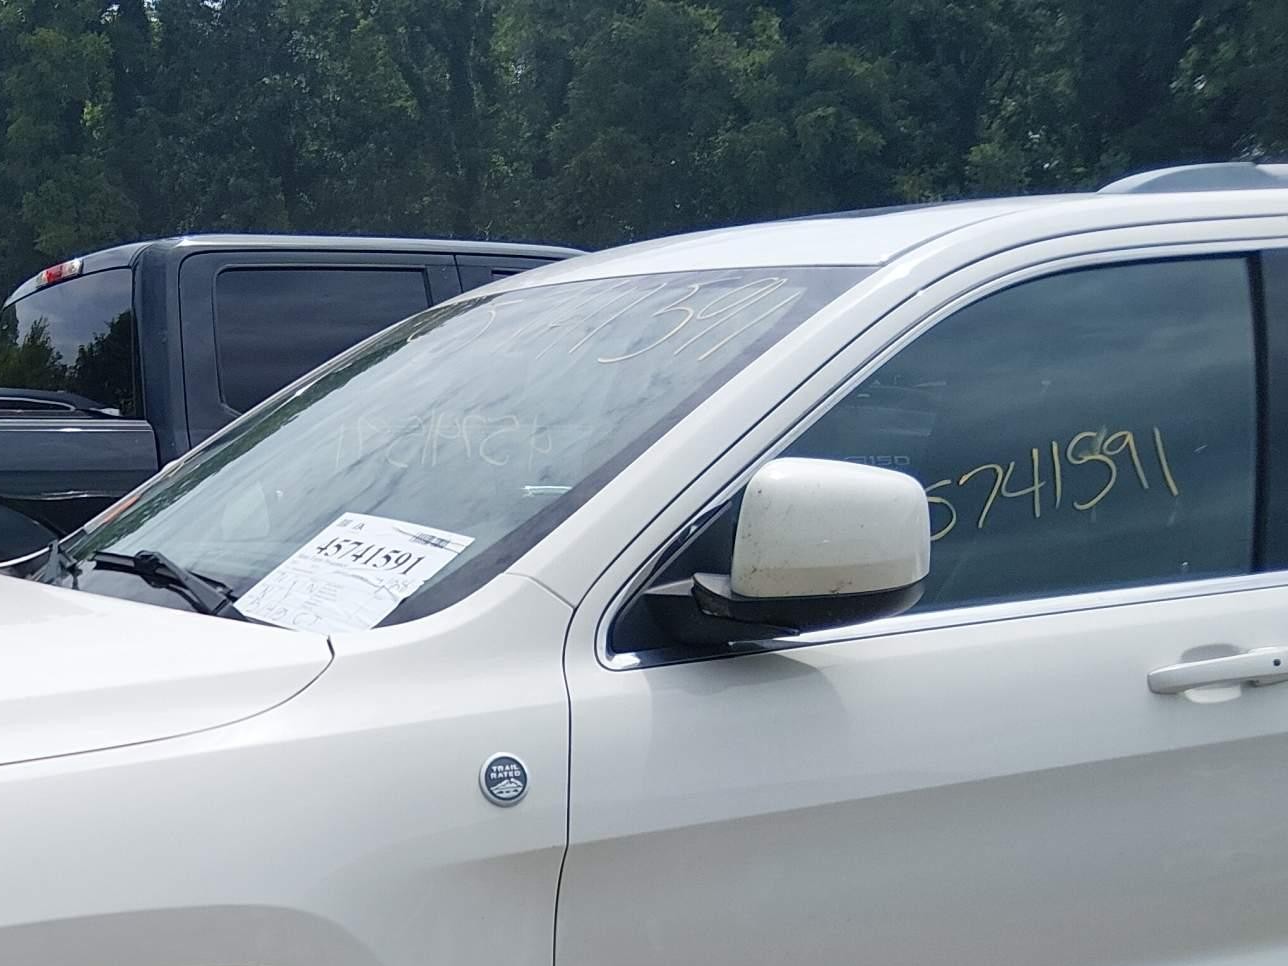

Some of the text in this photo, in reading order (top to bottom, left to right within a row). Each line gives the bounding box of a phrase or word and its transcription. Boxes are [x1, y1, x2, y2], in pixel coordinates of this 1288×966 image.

[316, 537, 426, 576] 45741591
[491, 764, 521, 773] TRAIL
[490, 770, 521, 780] RATED
